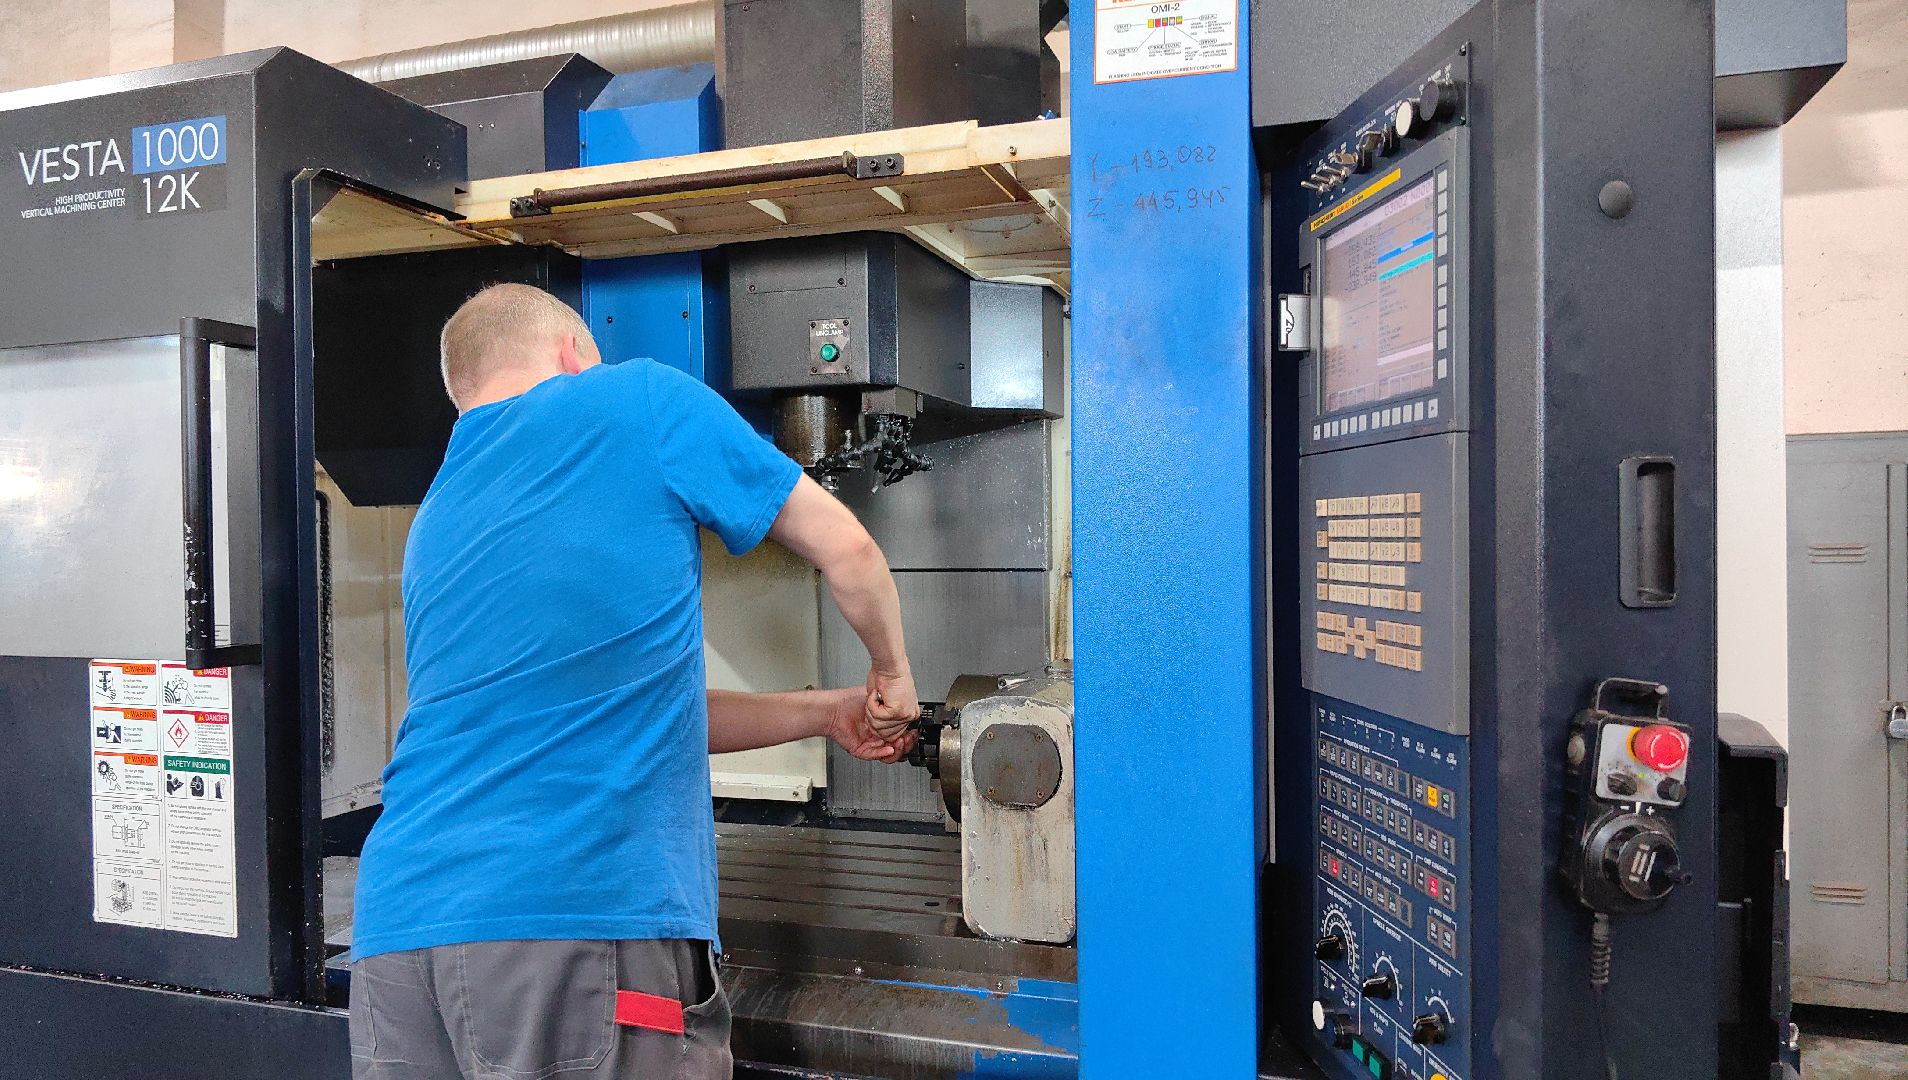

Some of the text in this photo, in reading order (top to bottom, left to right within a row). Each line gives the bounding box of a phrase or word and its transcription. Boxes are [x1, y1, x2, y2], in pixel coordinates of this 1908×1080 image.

[1151, 3, 1180, 14] OMI-2
[18, 122, 219, 185] VESTA 1000
[55, 188, 126, 206] HIGH PRODUCTIVITY
[142, 171, 201, 213] 12K
[20, 197, 126, 219] VERTICAL MACHINING CENTER
[204, 667, 228, 676] DANGER
[131, 710, 156, 719] WARNING
[204, 713, 228, 722] DANGER
[131, 756, 157, 765] WARNING
[167, 760, 227, 770] SAFETY INDICATION
